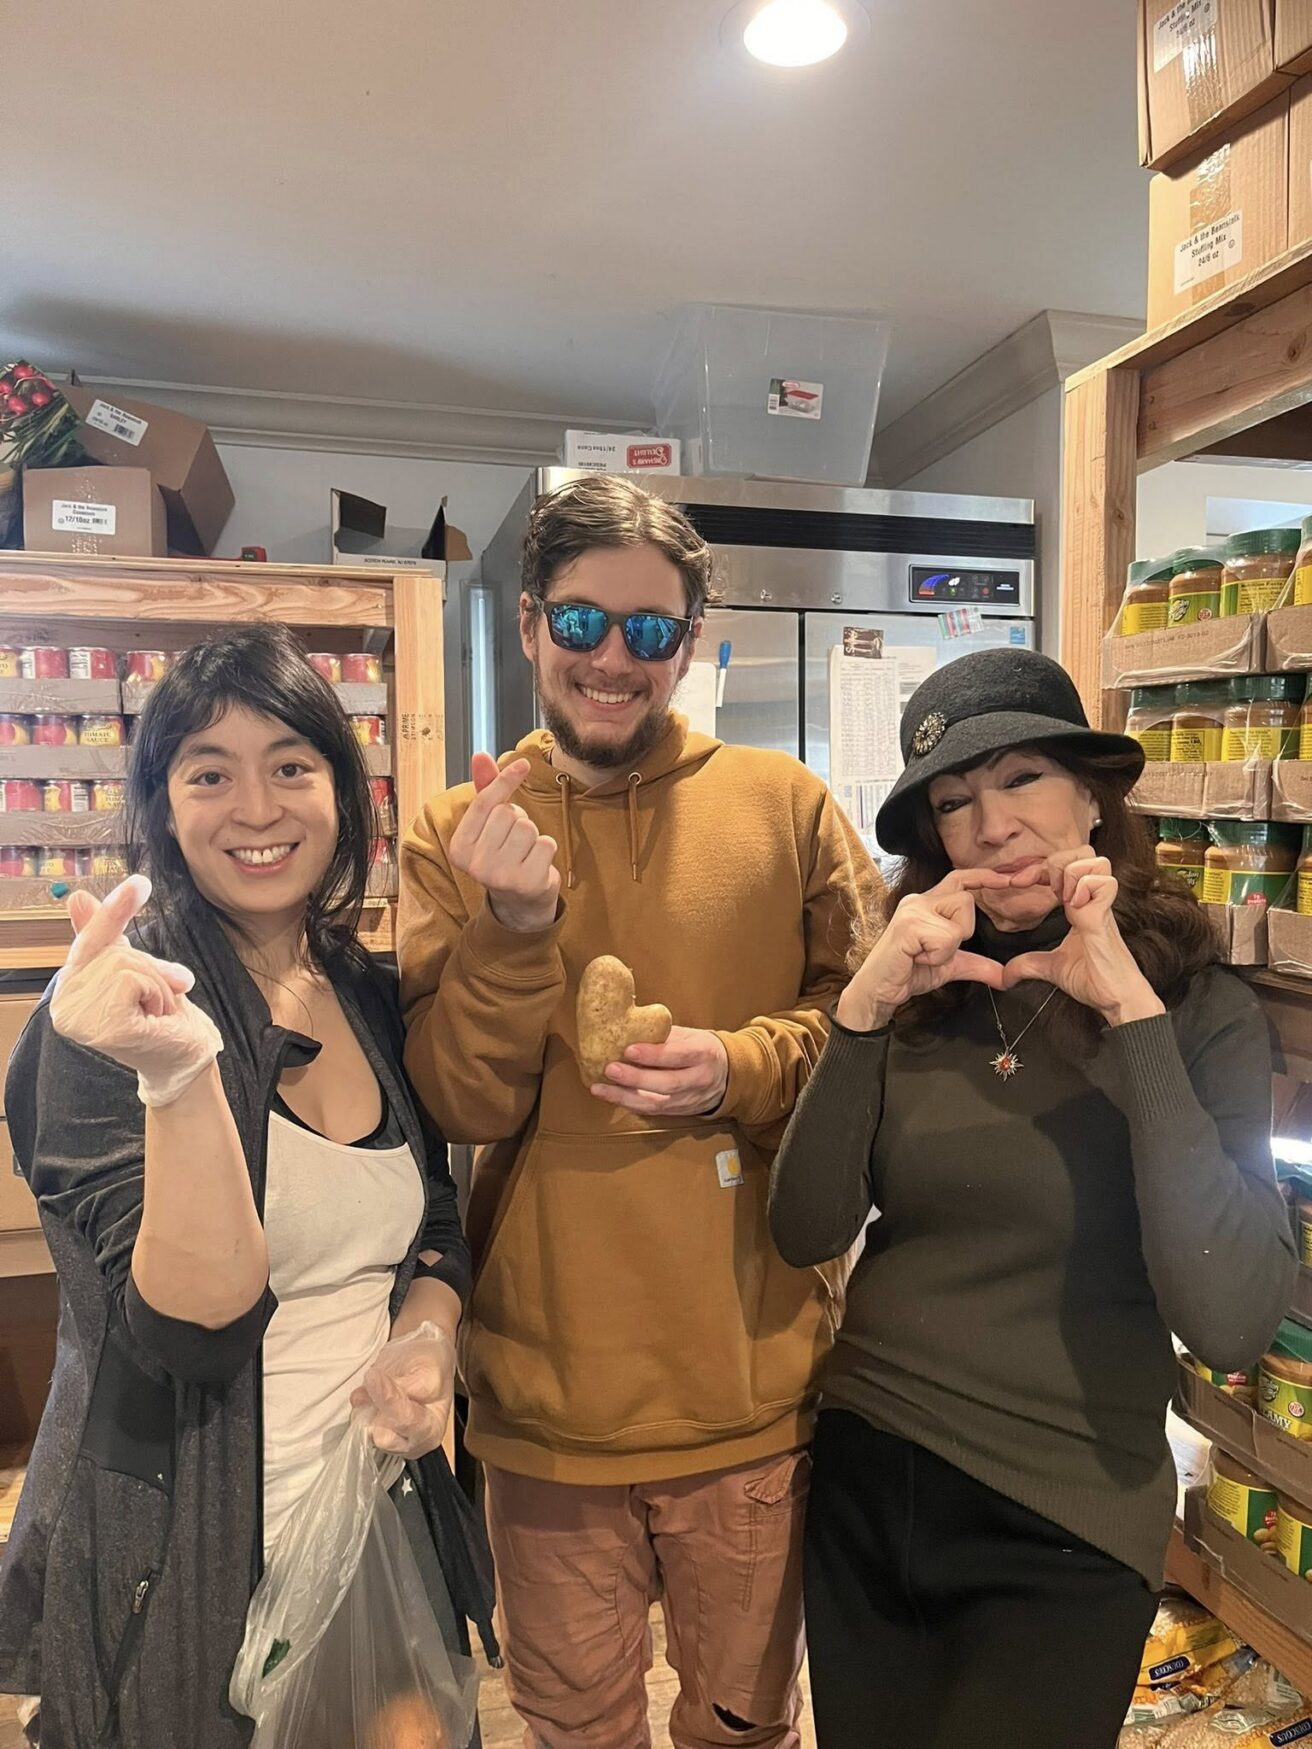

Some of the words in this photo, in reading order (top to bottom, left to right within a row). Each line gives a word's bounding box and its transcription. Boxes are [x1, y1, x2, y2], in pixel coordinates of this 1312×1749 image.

[1180, 240, 1192, 252] Jack
[1194, 235, 1199, 244] &
[1211, 214, 1240, 235] Beanstalk
[1216, 234, 1226, 245] Mix
